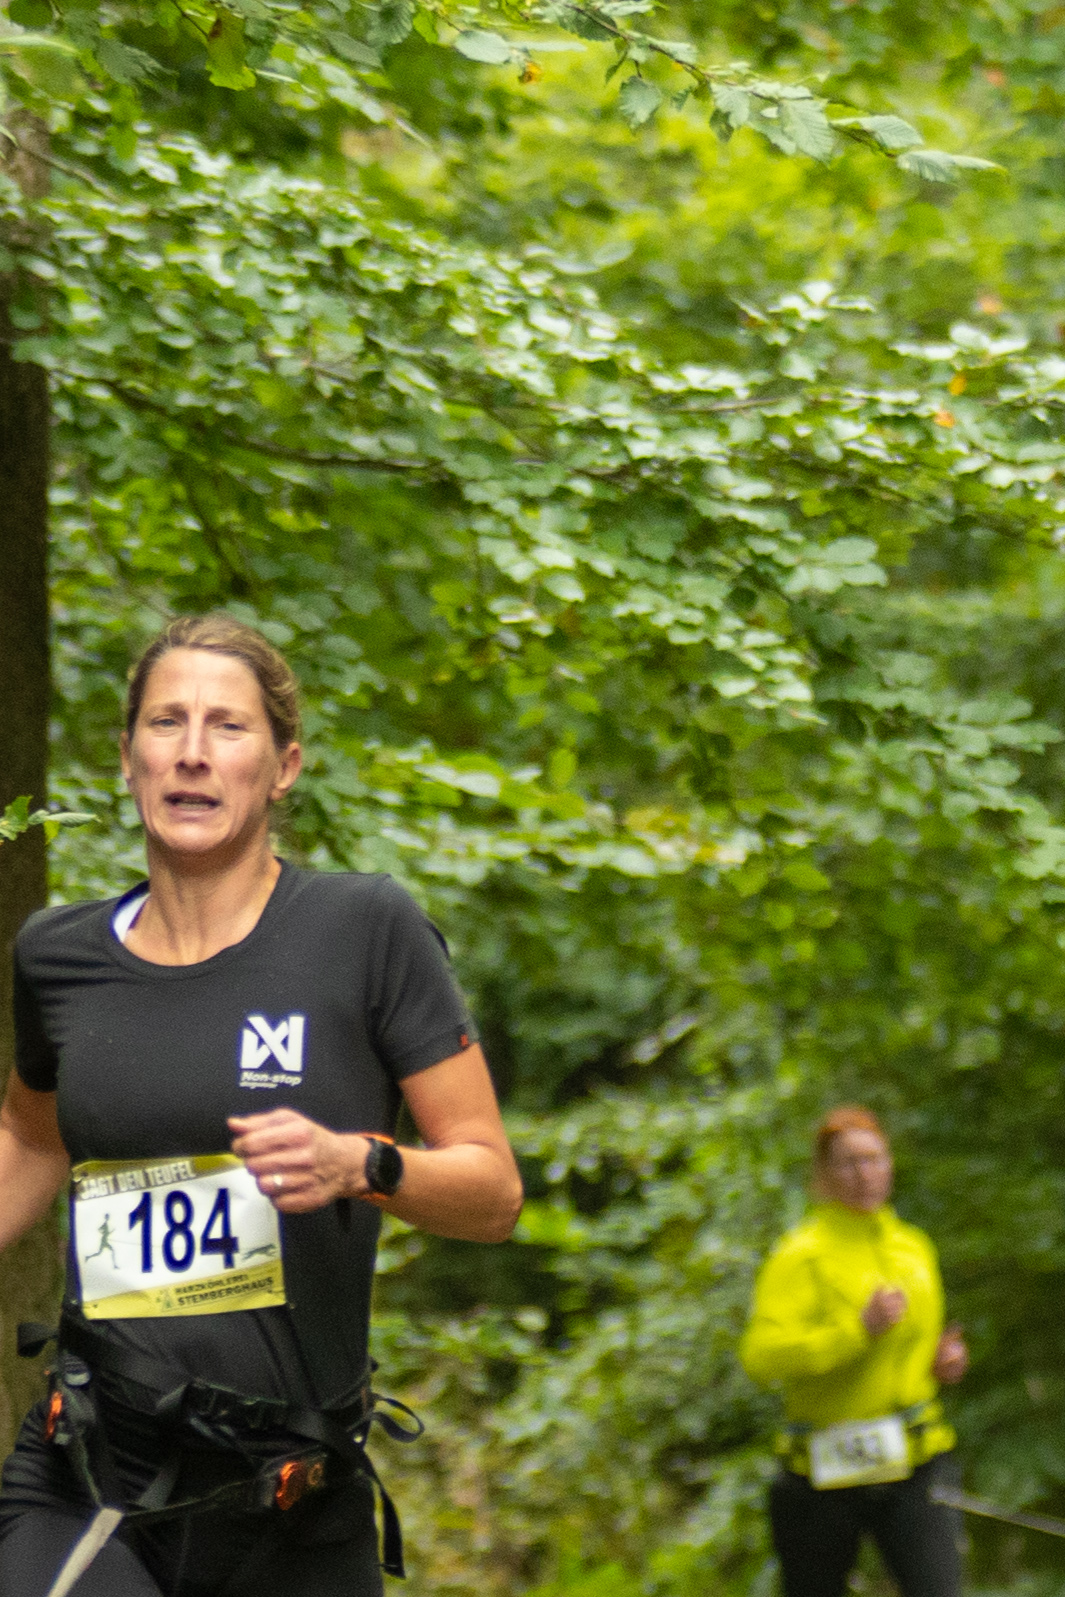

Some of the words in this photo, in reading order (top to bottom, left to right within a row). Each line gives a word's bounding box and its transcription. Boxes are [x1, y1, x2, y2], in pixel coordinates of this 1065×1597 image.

[117, 1168, 146, 1192] DEN
[145, 1160, 197, 1188] TEUFEL
[128, 1187, 240, 1274] 184
[177, 1276, 274, 1306] STEMBERGHAUS
